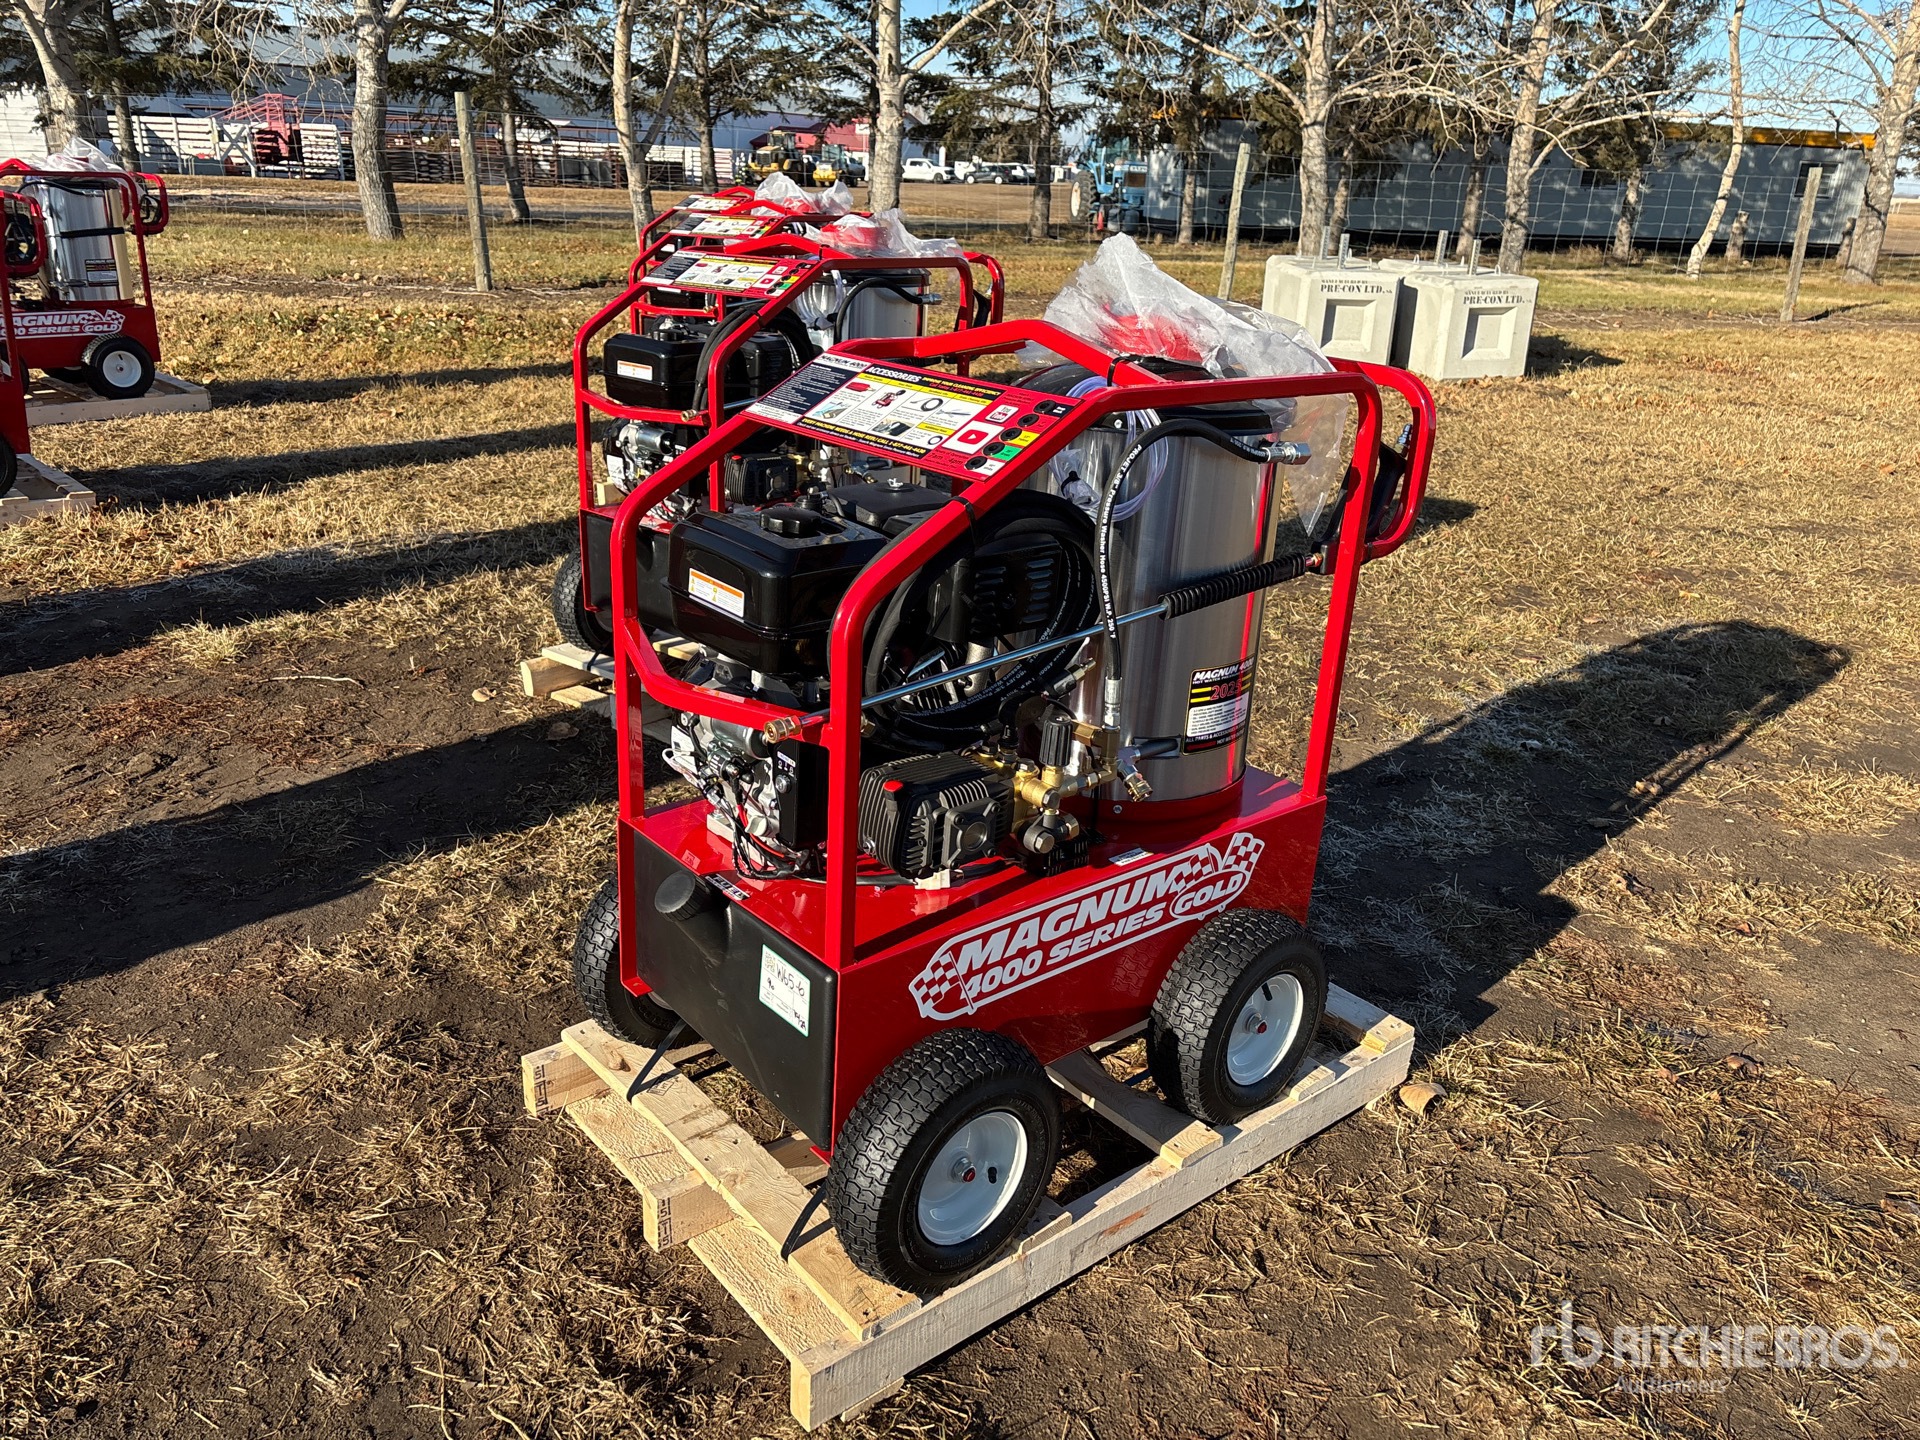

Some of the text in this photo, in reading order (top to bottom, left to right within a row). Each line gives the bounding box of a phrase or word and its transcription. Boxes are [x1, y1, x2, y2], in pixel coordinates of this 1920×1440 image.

[1320, 284, 1362, 293] PRE-CON
[1364, 286, 1385, 294] LTD.
[1463, 296, 1503, 304] PRE-CON
[1505, 296, 1525, 304] LTD.
[28, 325, 80, 334] SERIES
[84, 324, 118, 332] GOLD
[867, 366, 922, 382] ACCESSORIES
[1120, 444, 1142, 473] PROJET
[1102, 489, 1116, 524] Pressure
[1100, 525, 1108, 554] Washer
[1101, 574, 1110, 602] 4500PSI
[1104, 602, 1112, 618] W.P.
[1193, 664, 1240, 681] MAGNUM
[713, 876, 744, 899] FUEL
[1176, 874, 1242, 914] GOLD
[957, 864, 1188, 972] MAGNUM
[960, 901, 1167, 1000] 4000 SERIES
